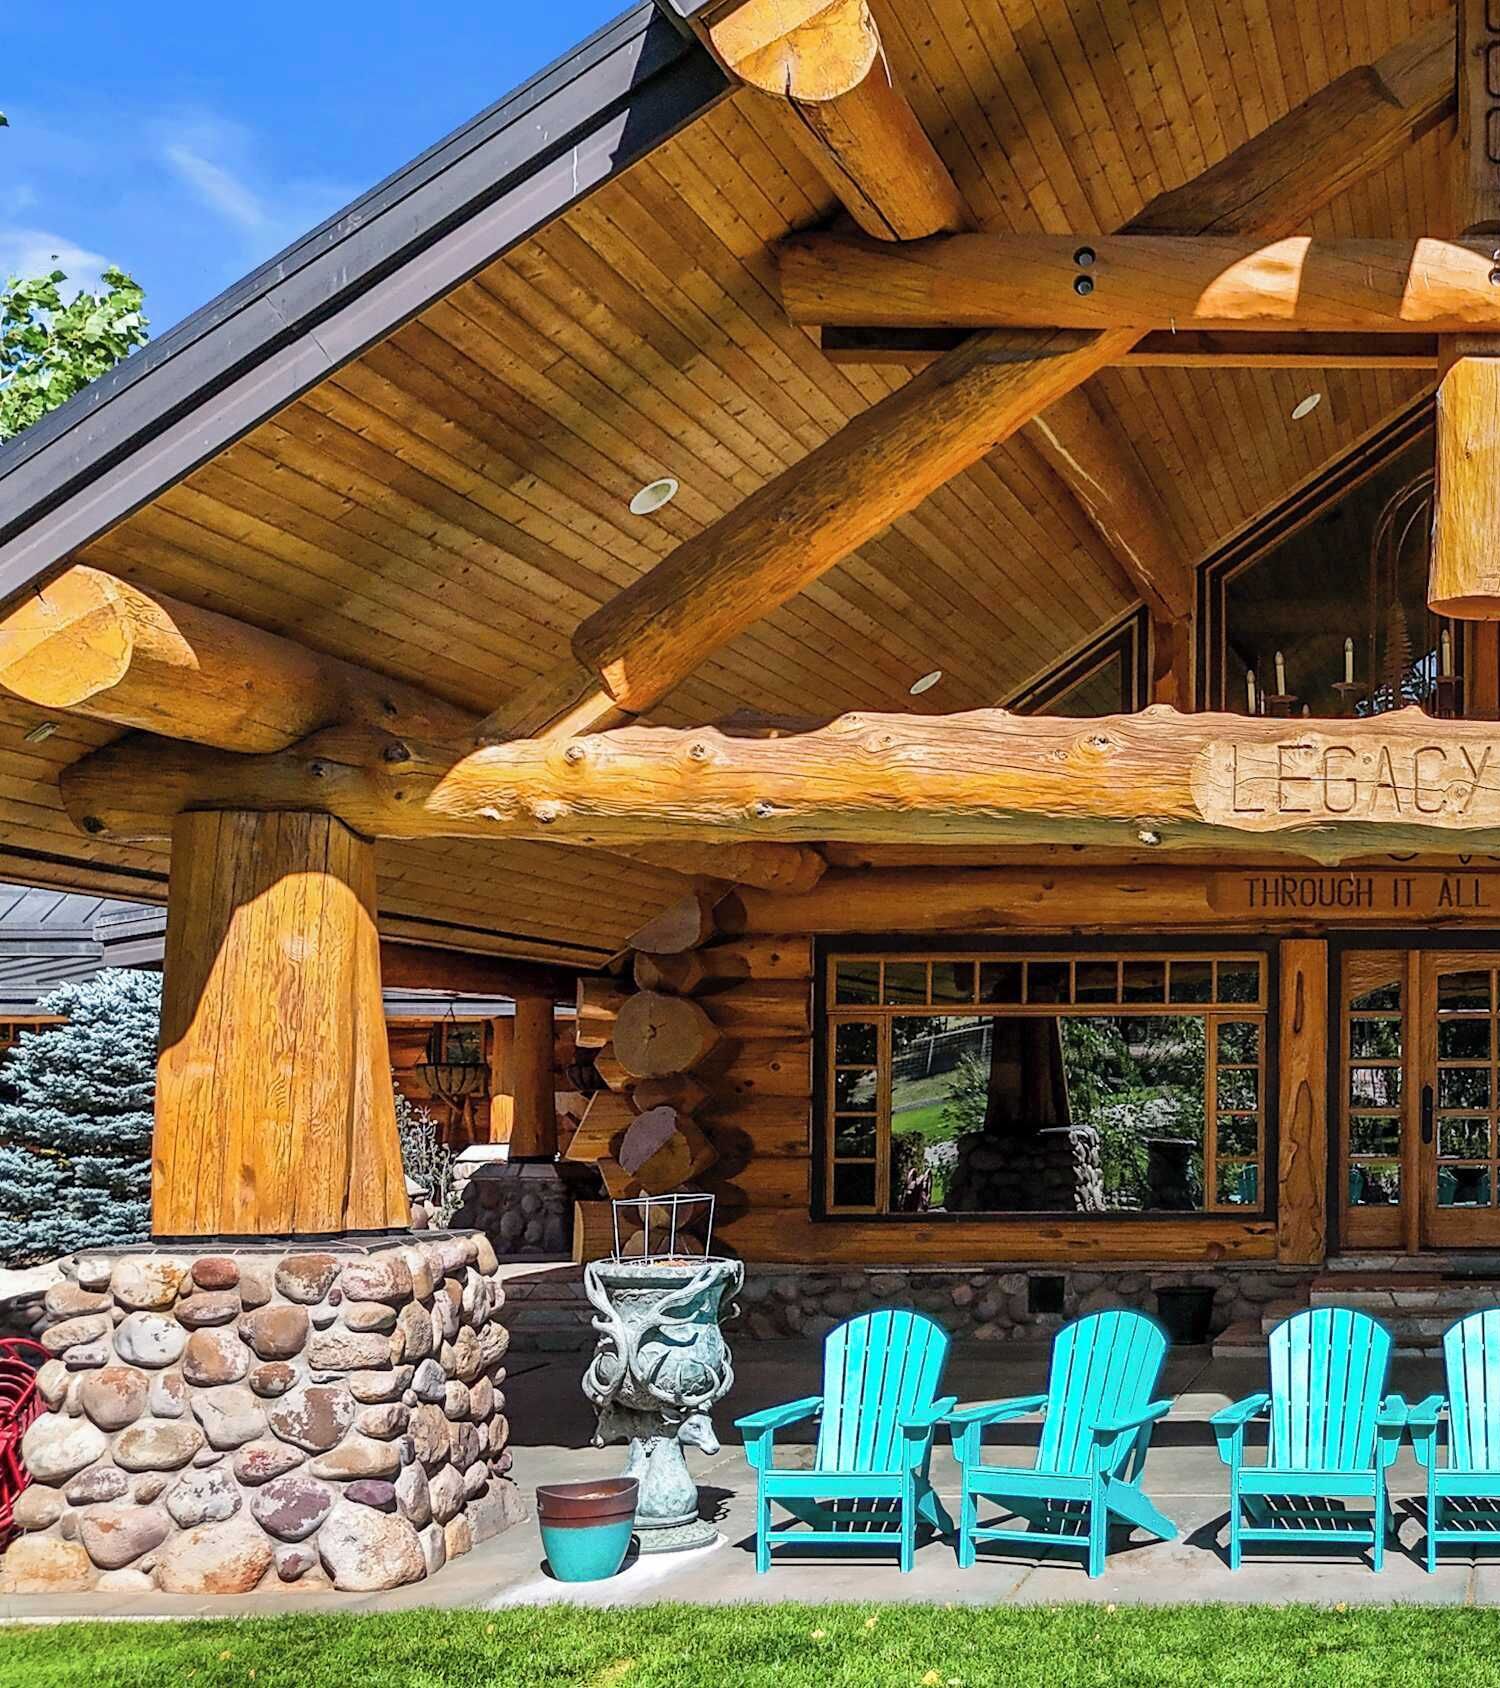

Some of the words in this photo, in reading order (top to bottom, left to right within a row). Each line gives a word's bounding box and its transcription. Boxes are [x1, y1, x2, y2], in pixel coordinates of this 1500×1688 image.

[1233, 745, 1492, 814] LEGACY
[1244, 876, 1374, 907] THROUGH
[1393, 878, 1417, 907] IT
[1438, 878, 1491, 908] ALL
